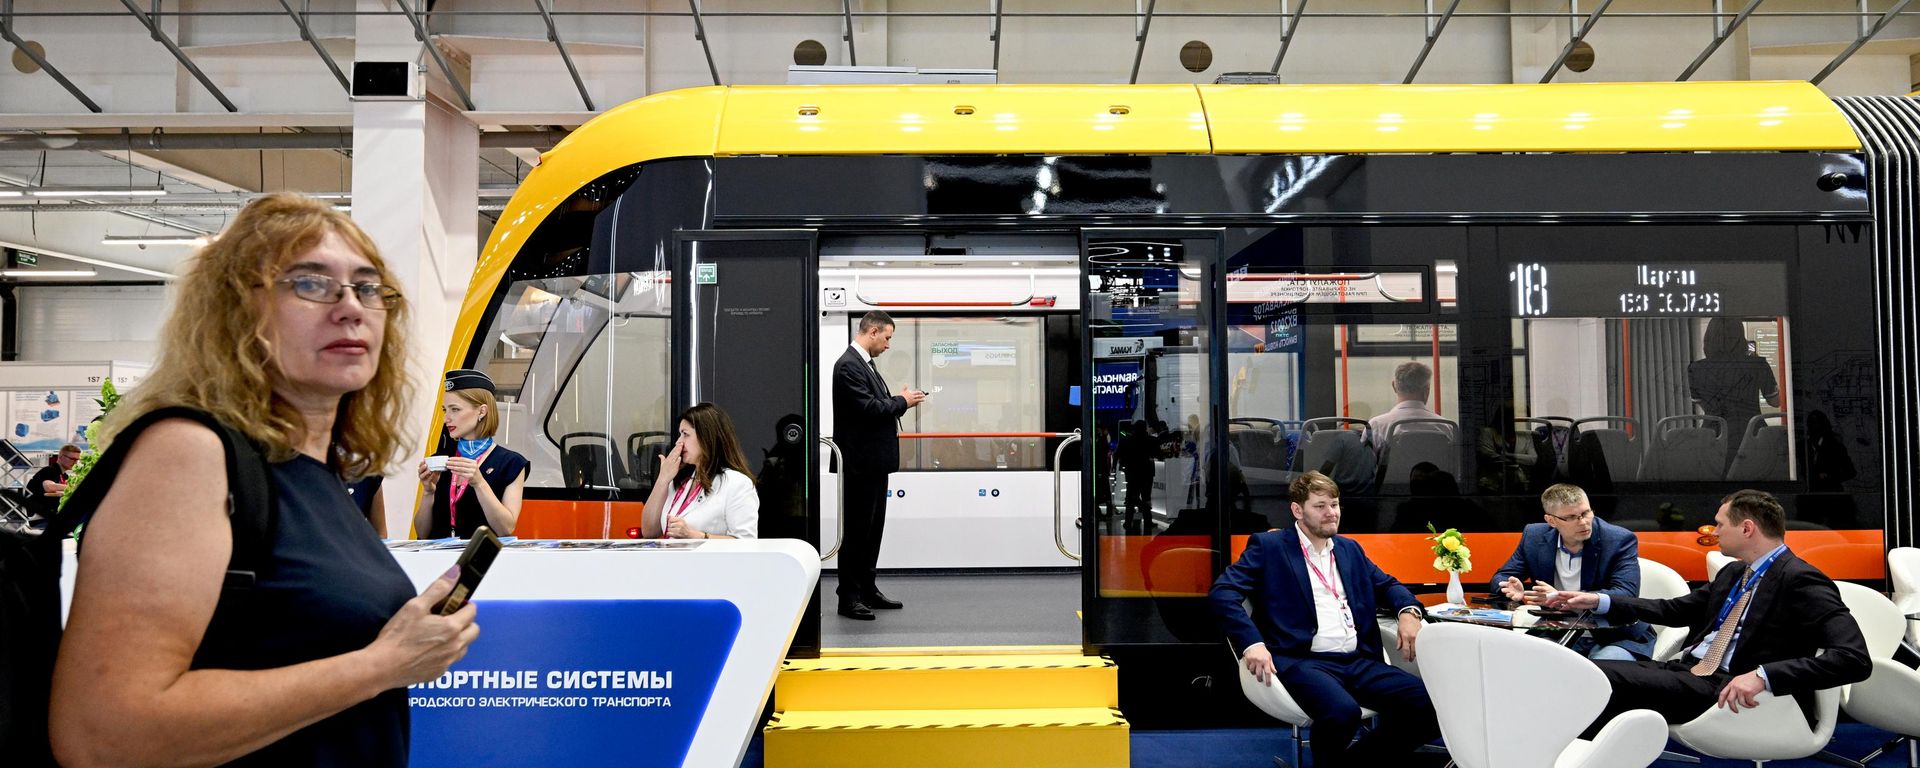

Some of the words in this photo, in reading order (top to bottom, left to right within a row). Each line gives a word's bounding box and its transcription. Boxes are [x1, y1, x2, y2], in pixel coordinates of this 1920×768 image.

[1509, 263, 1548, 316] 18
[546, 671, 673, 689] СИСТЕМЫ
[408, 697, 475, 708] РОДСКОГО
[479, 697, 587, 708] ЭЛЕКТРИЧЕСКОГО
[591, 697, 672, 708] ТРАНСПОРТА
